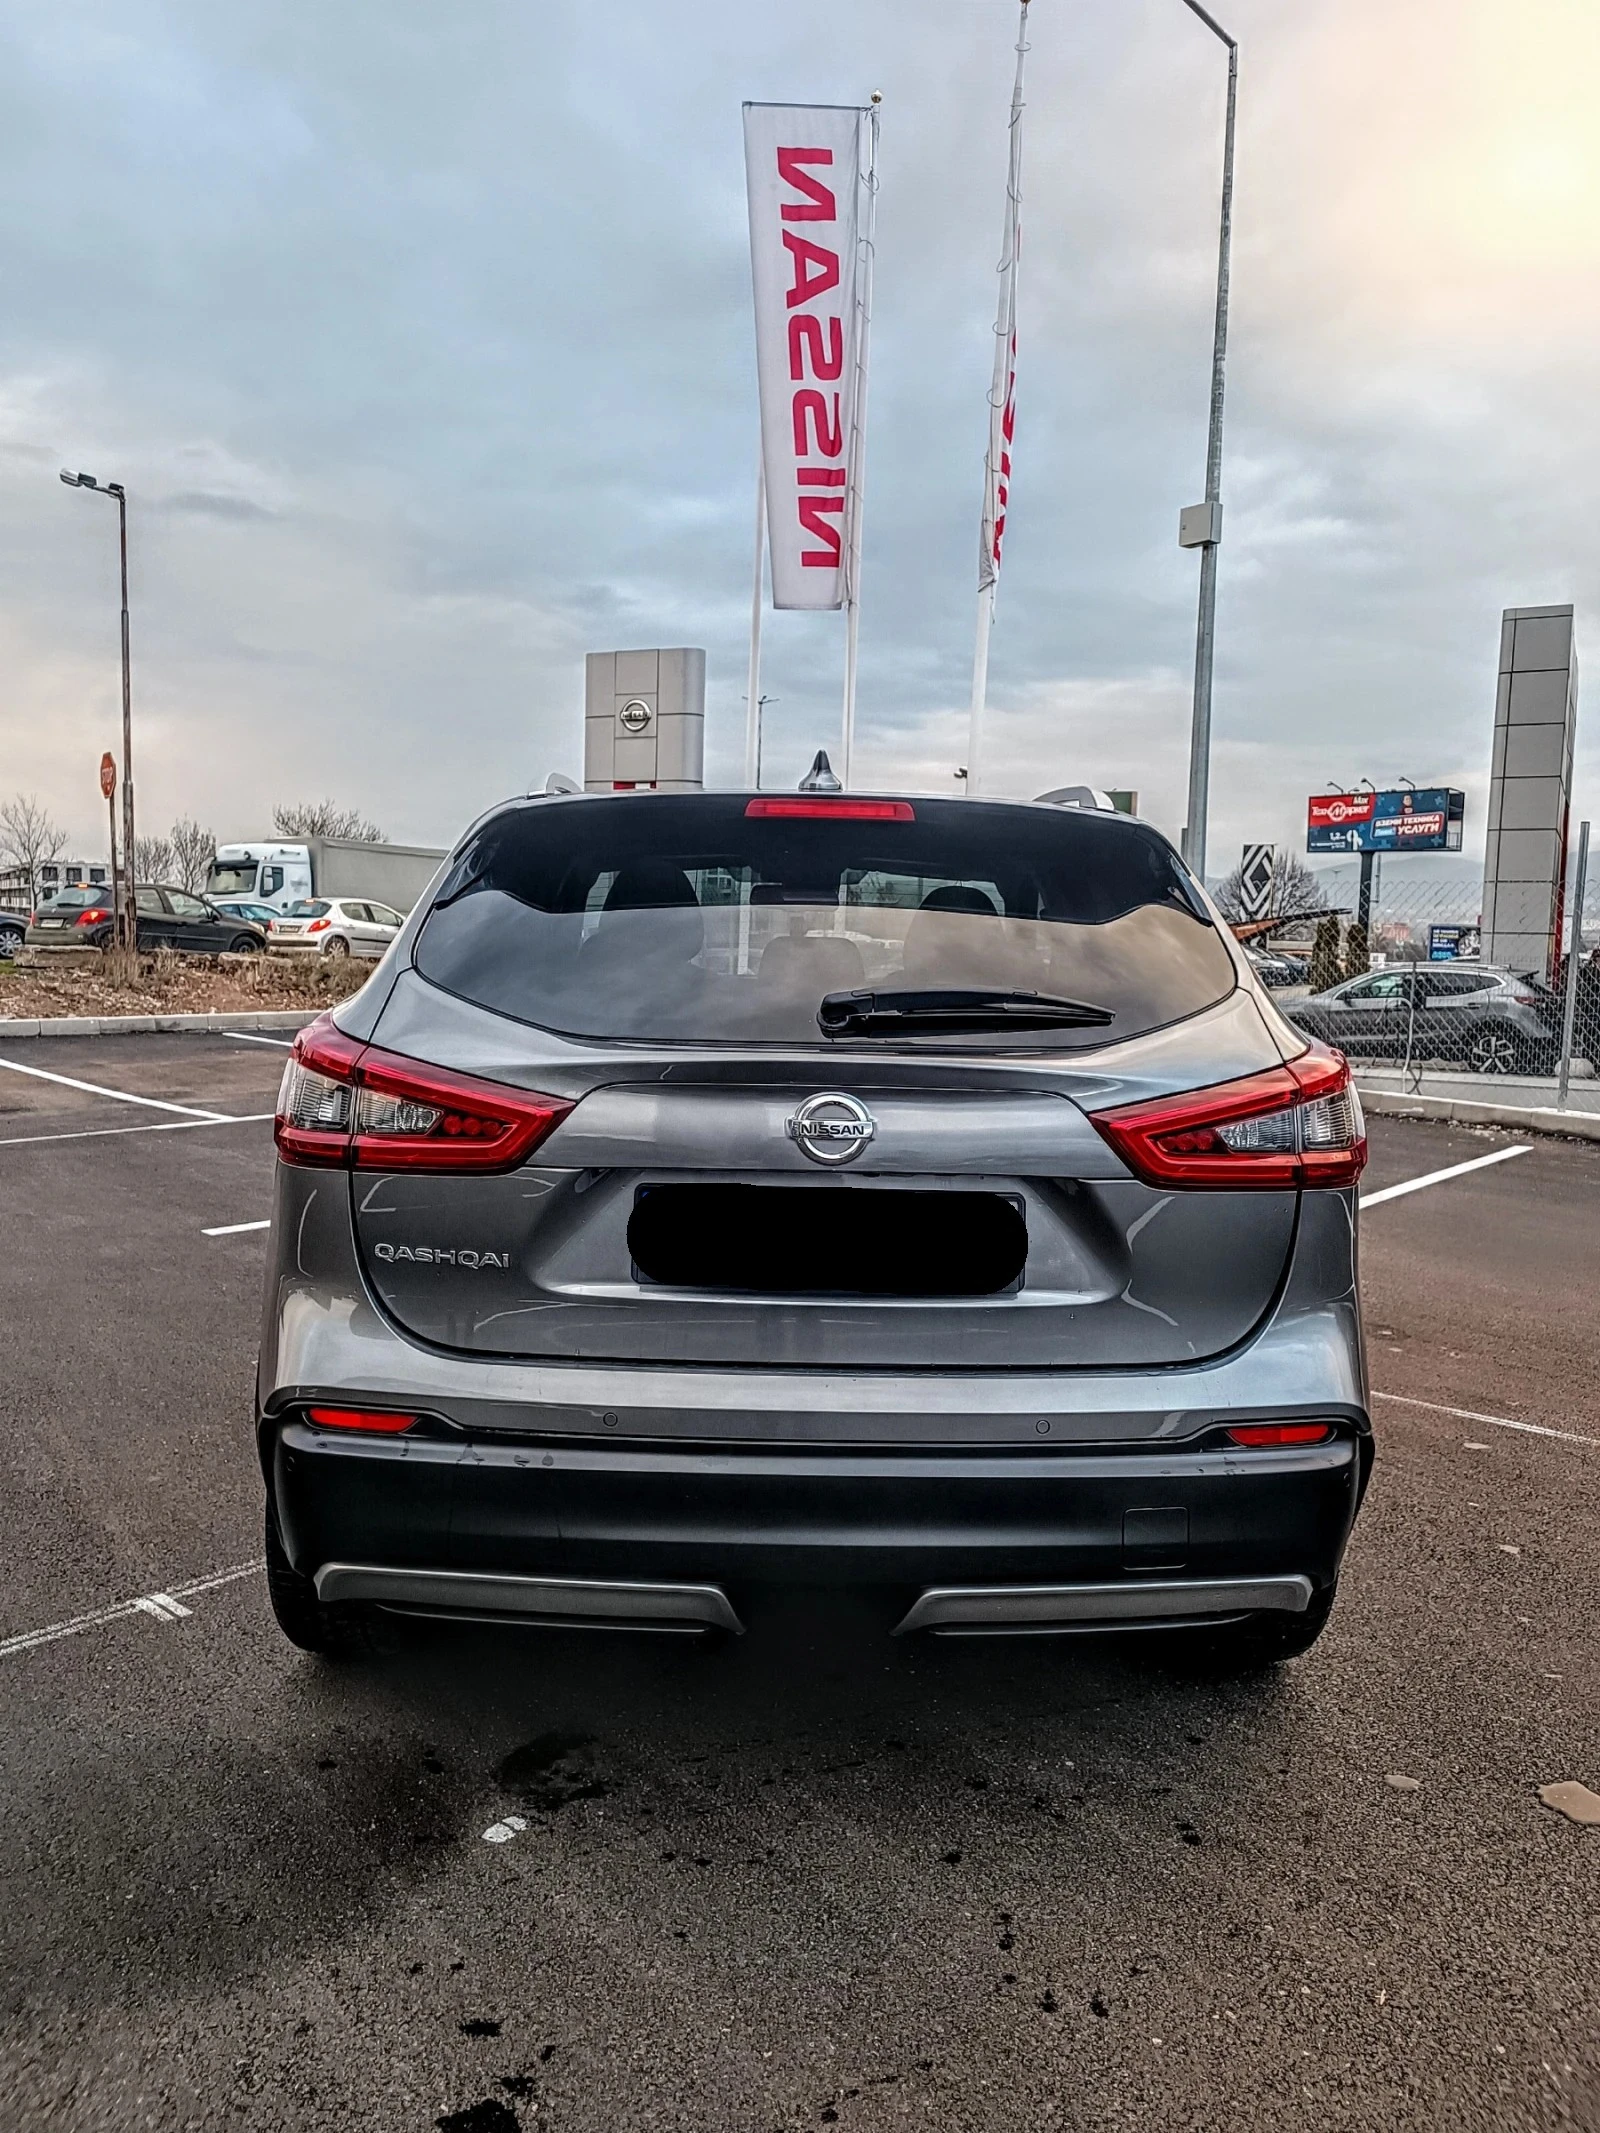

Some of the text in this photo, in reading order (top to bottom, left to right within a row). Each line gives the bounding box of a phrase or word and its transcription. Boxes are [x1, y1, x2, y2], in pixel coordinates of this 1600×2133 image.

[1403, 815, 1440, 825] ТЕХНИКА
[1397, 823, 1440, 835] УСЛУГИ
[801, 1125, 864, 1135] NISSAN
[374, 1243, 510, 1270] QASHQAI
